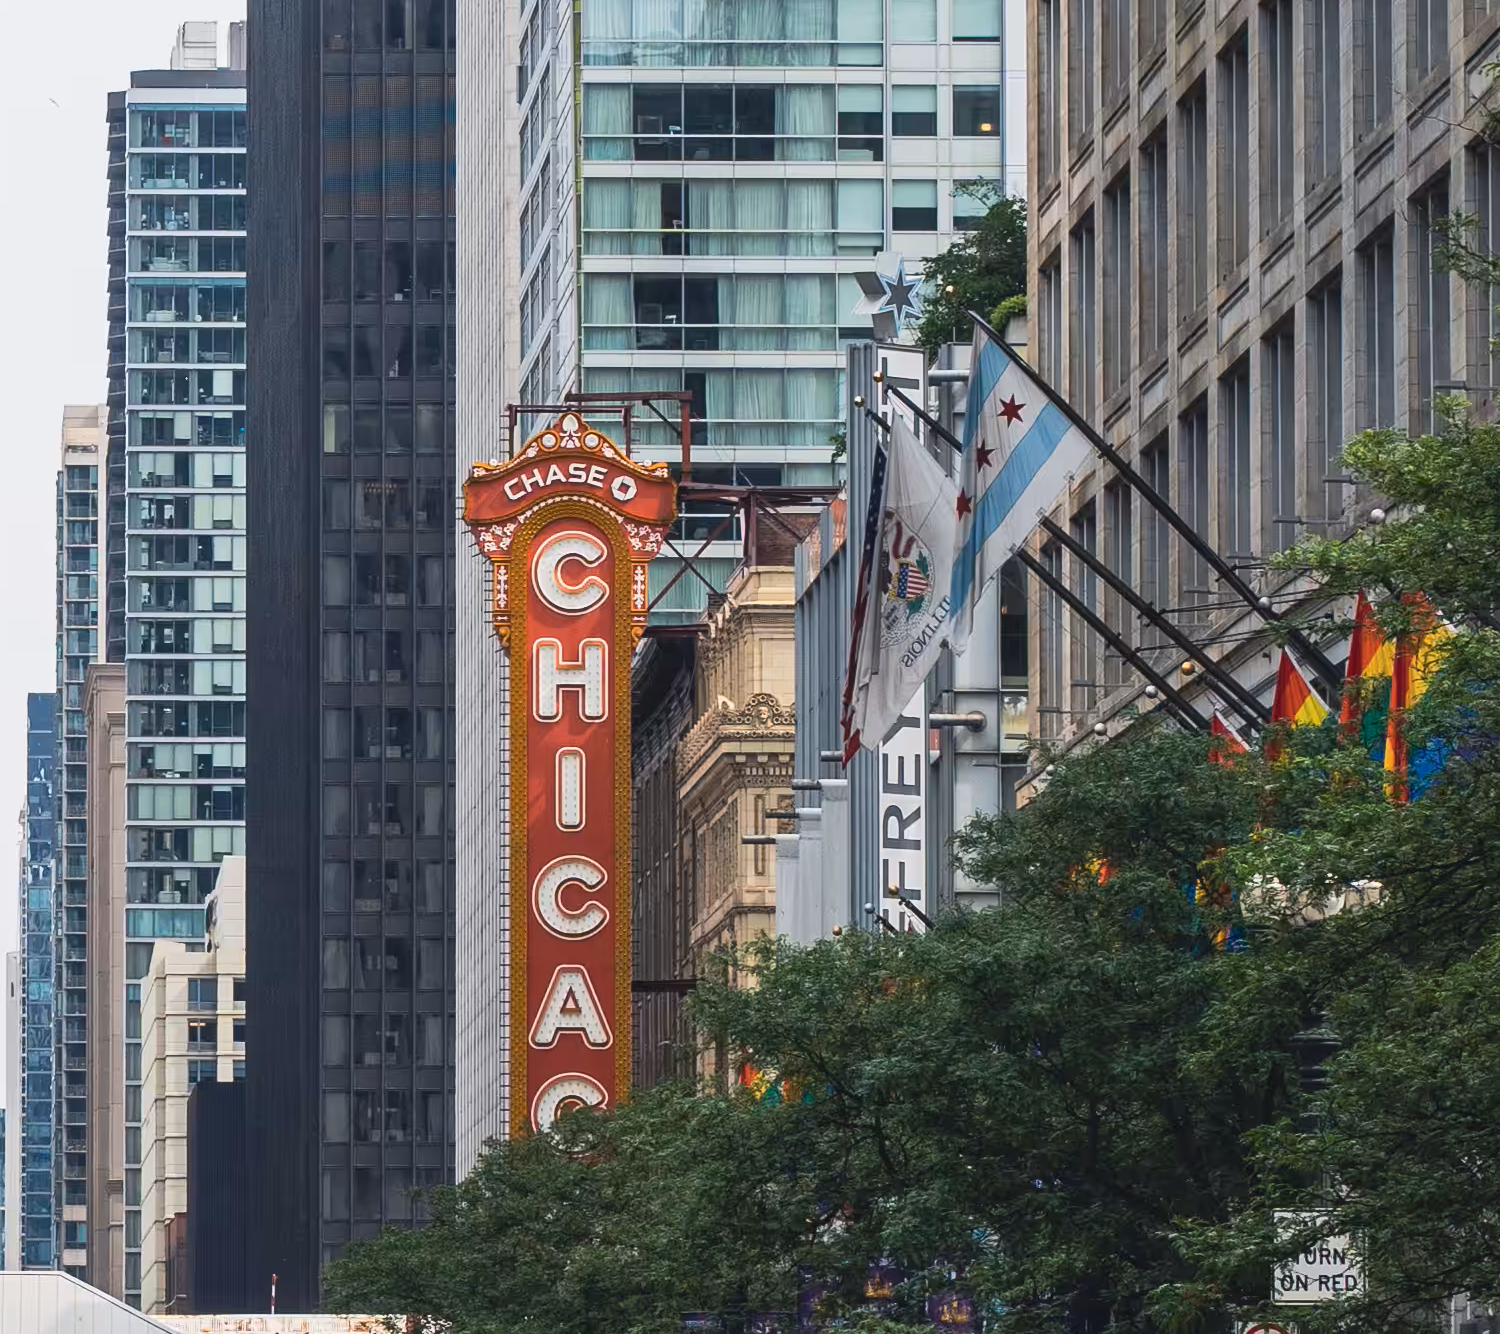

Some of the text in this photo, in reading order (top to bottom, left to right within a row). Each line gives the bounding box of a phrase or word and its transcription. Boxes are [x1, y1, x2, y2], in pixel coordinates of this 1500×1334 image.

[503, 462, 608, 501] CHASE
[530, 530, 613, 1147] CHICAG
[1281, 1274, 1357, 1292] ON RED
